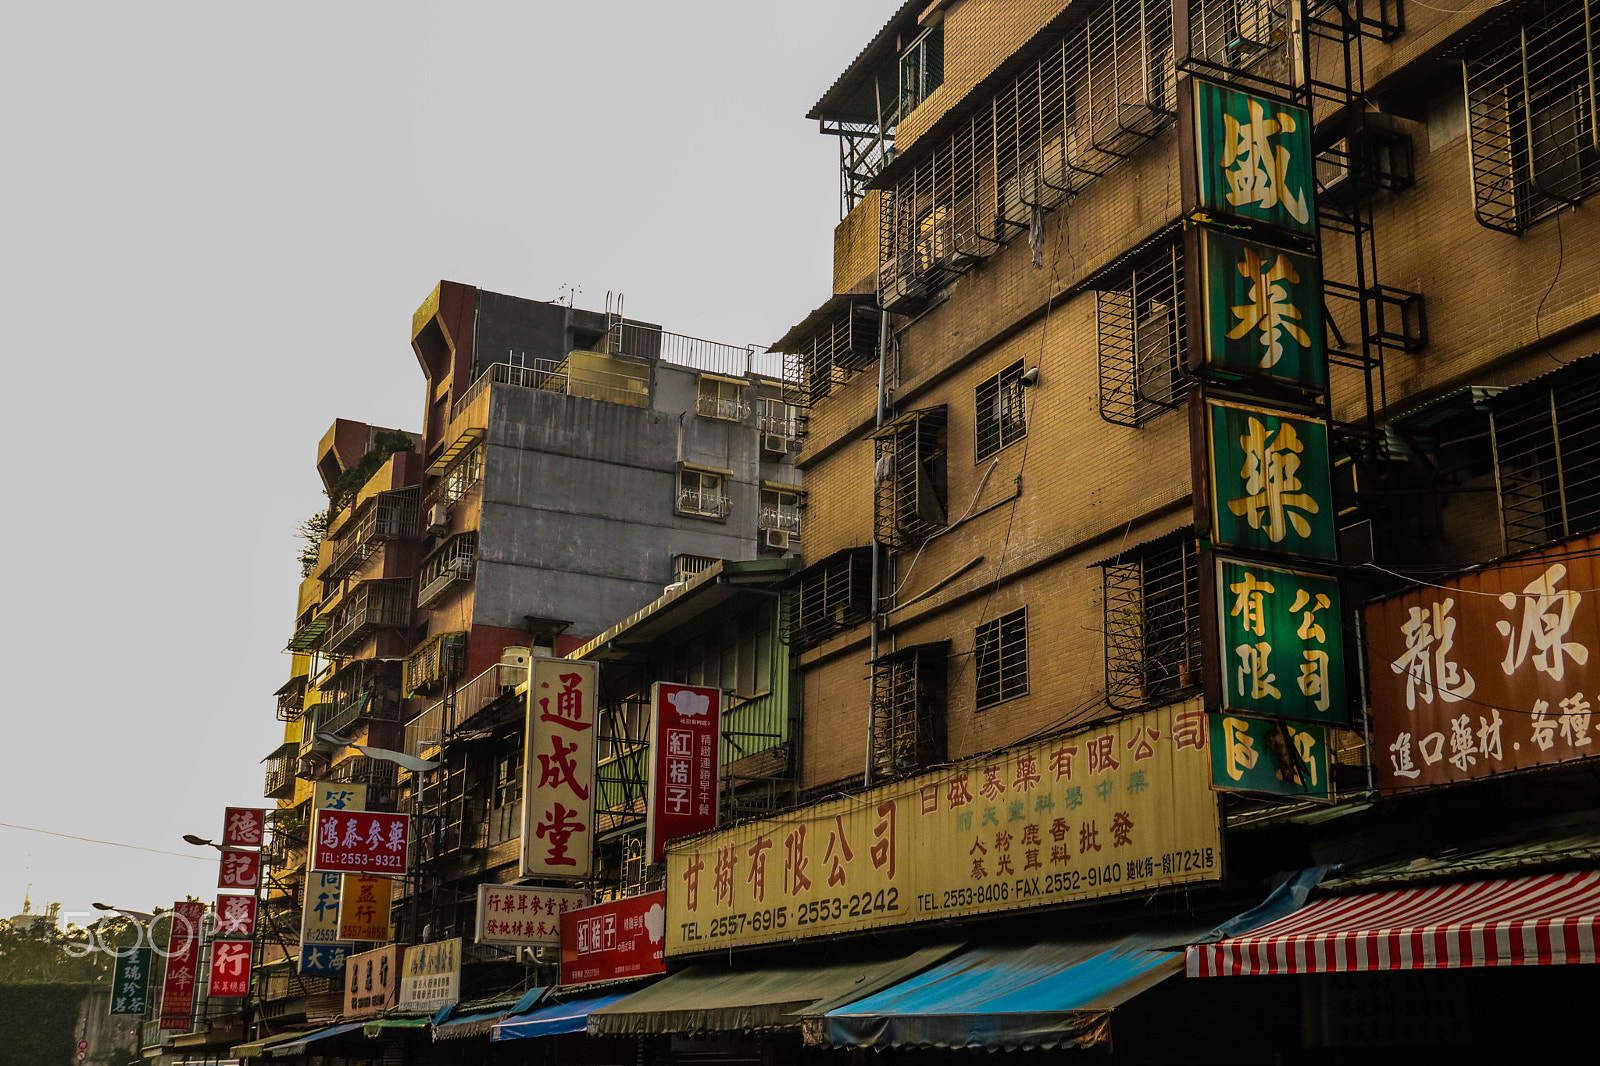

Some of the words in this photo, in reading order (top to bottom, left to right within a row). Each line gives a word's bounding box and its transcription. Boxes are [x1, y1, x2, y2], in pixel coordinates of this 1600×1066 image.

[1390, 562, 1589, 711] 龍源
[535, 672, 592, 866] 通成堂
[667, 731, 692, 813] 紅桔子
[956, 769, 1150, 833] 順天堂科學中藥
[682, 798, 897, 913] 甘樹有限公司
[1079, 811, 1134, 854] 批發
[214, 810, 261, 977] 德記藥行
[578, 916, 616, 953] 紅桔子
